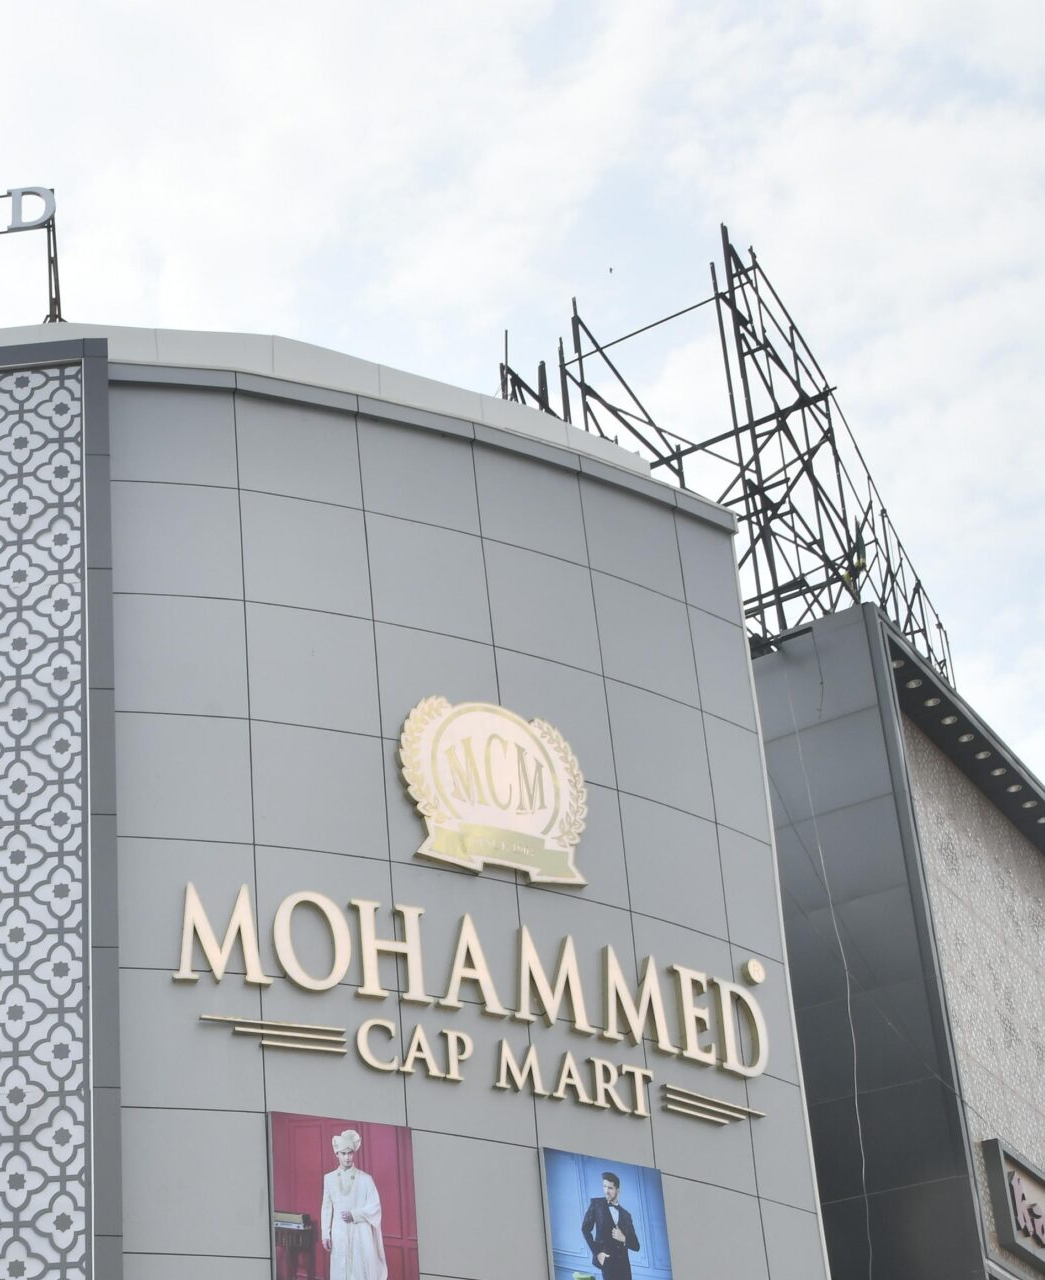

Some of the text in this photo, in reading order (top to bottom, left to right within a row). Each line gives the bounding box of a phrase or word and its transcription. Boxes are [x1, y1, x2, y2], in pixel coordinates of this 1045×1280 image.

[444, 733, 546, 817] MCM
[172, 882, 768, 1078] MOHAMMED
[357, 1018, 653, 1118] CAP MART
